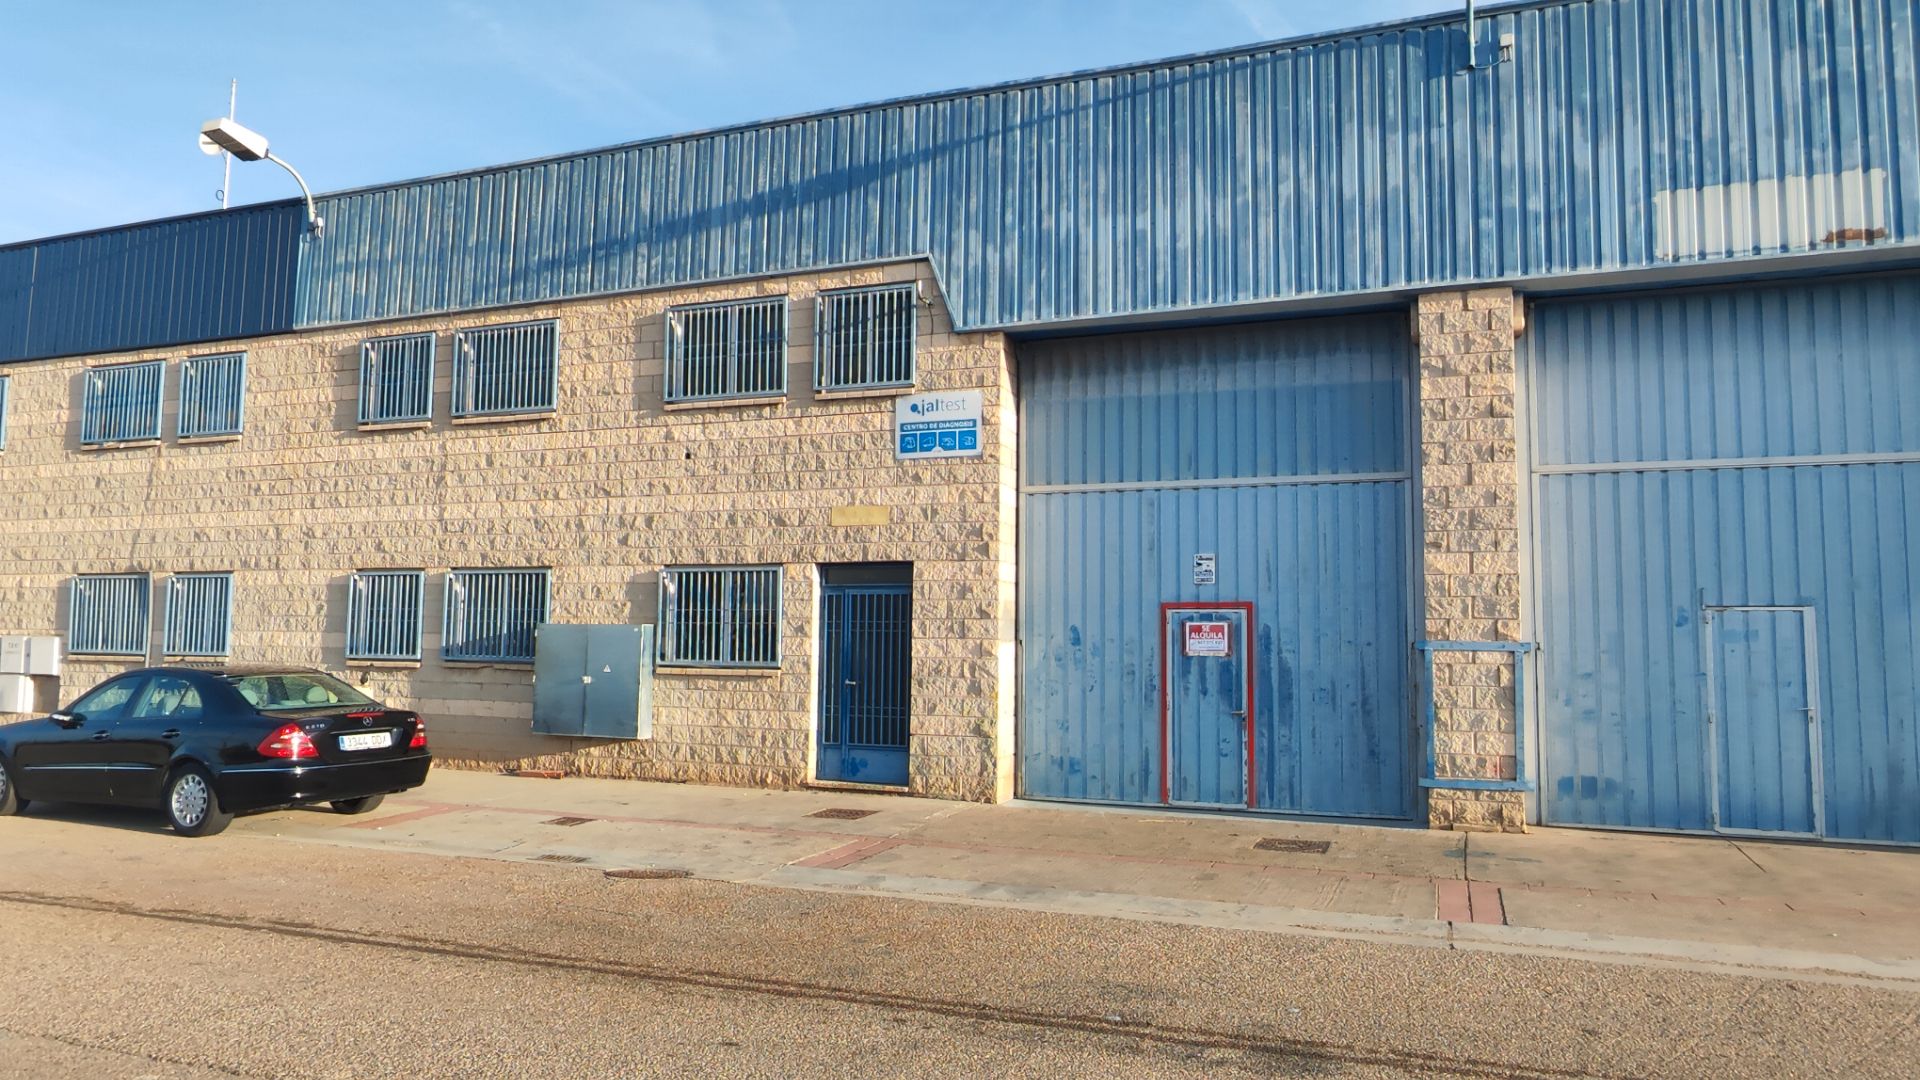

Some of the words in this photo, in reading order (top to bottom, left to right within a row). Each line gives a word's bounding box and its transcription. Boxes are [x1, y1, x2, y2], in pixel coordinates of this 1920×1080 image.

[921, 397, 966, 416] jaltest
[903, 423, 927, 431] CENTRO
[1201, 624, 1210, 632] SE
